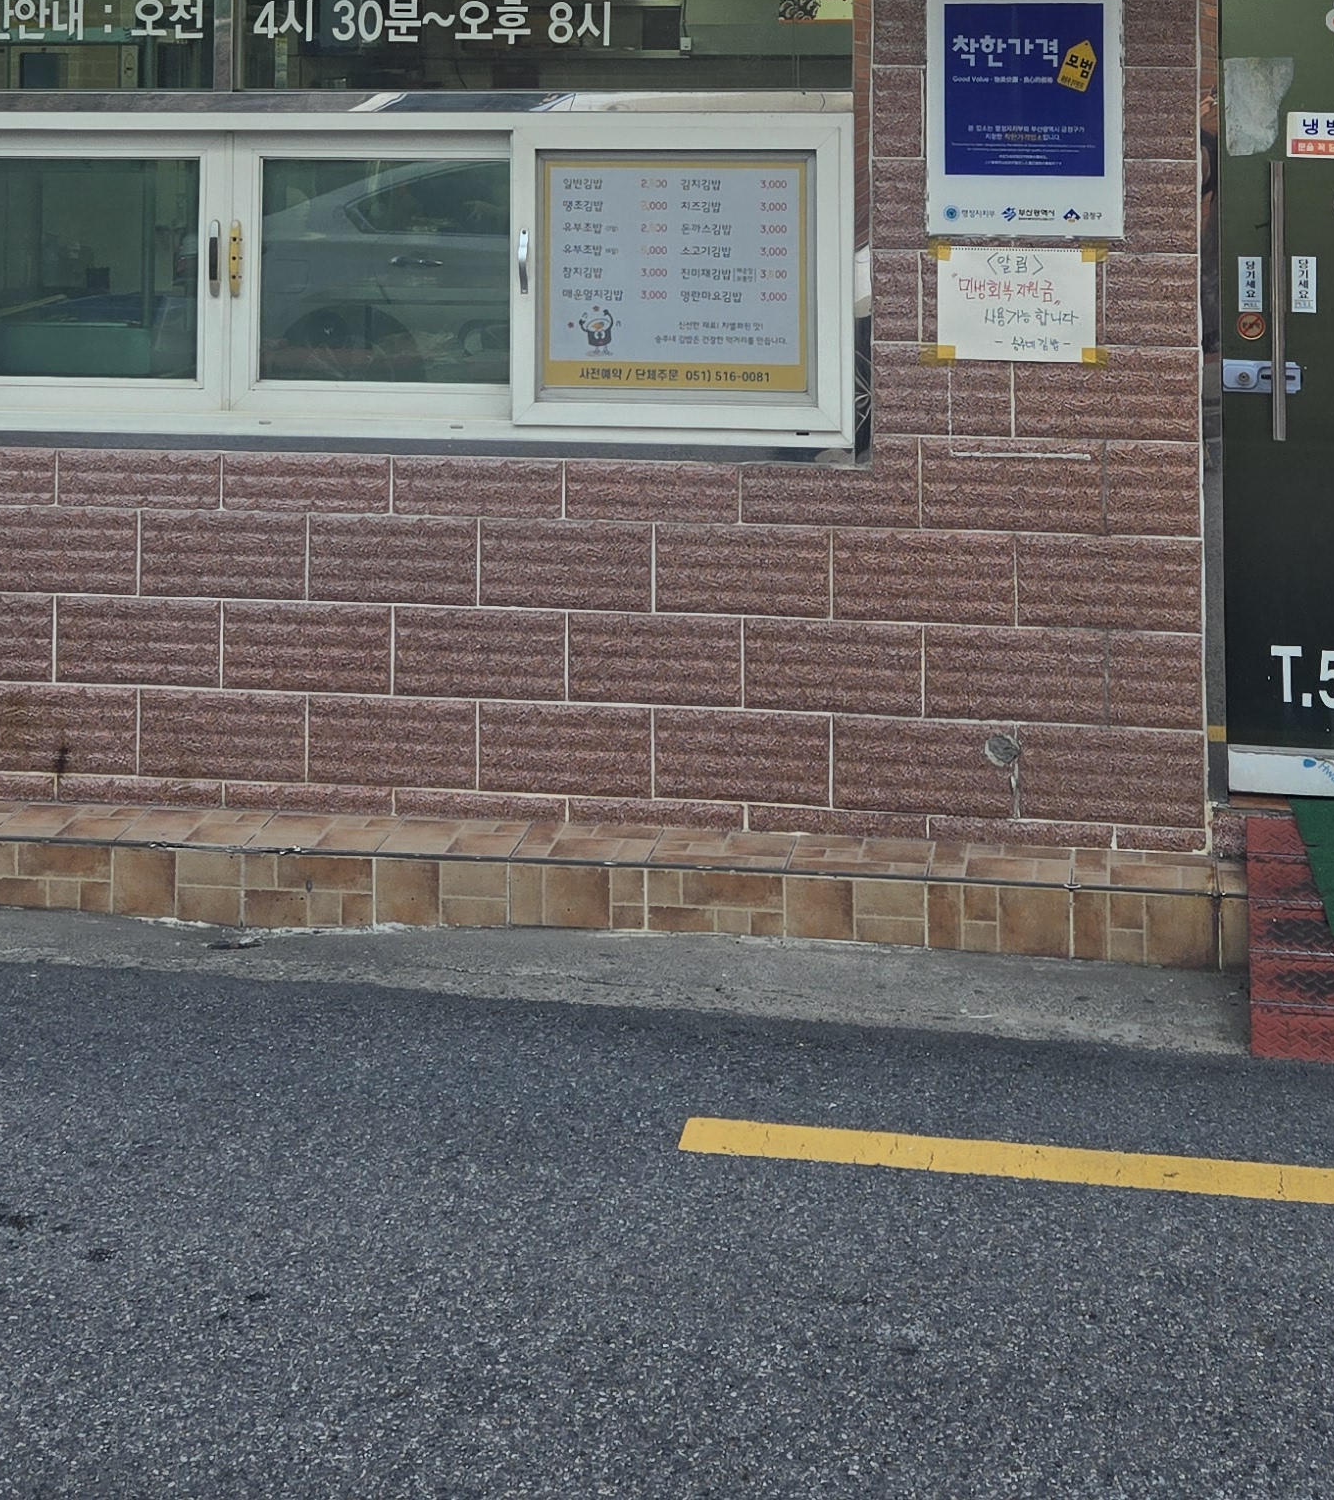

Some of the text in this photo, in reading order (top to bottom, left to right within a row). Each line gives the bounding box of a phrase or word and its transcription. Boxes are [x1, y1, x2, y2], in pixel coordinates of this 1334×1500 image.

[548, 0, 612, 47] 8시
[952, 35, 1059, 68] 착한가격
[1065, 53, 1094, 80] 모범
[952, 75, 971, 83] Good
[971, 75, 990, 83] Value
[562, 178, 603, 190] 일반김밥
[680, 179, 787, 191] 김치김밥 3,000
[680, 201, 787, 213] 치즈김밥 3,000
[1018, 208, 1056, 218] 부산광역시
[760, 224, 787, 234] 3,000
[681, 245, 787, 258] 소고기김밥 3,000
[562, 267, 668, 279] 참치김밥 3,000
[1245, 260, 1256, 298] 당기세요
[1298, 258, 1309, 299] 당기세요
[641, 290, 668, 300] 3,000
[760, 291, 787, 302] 3,000
[579, 367, 622, 379] 사전예약
[635, 369, 679, 381] 단체주문
[715, 370, 770, 383] 516-0081
